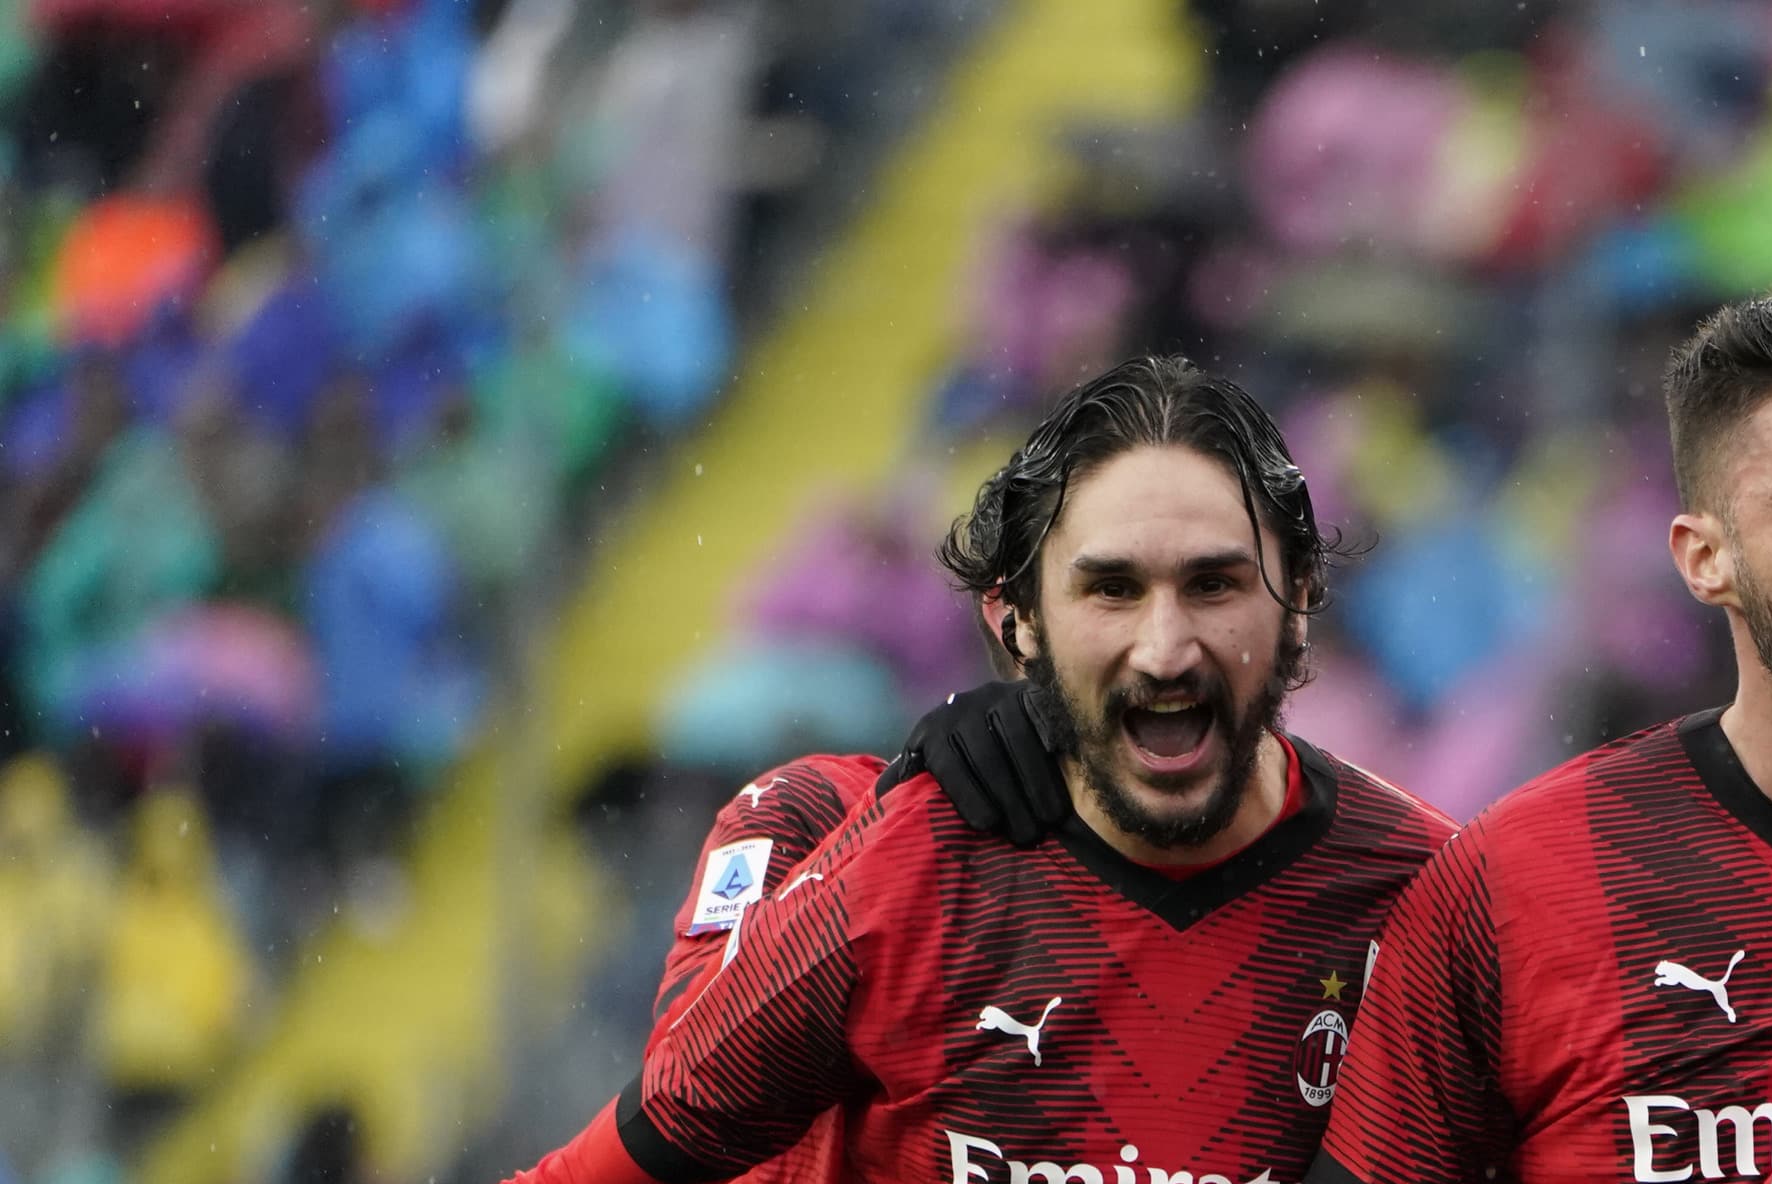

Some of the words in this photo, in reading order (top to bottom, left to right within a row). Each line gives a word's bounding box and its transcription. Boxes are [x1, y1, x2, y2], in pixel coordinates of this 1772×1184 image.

[706, 902, 741, 915] SERIE
[1311, 1012, 1344, 1034] ACM
[1304, 1086, 1332, 1100] 1899
